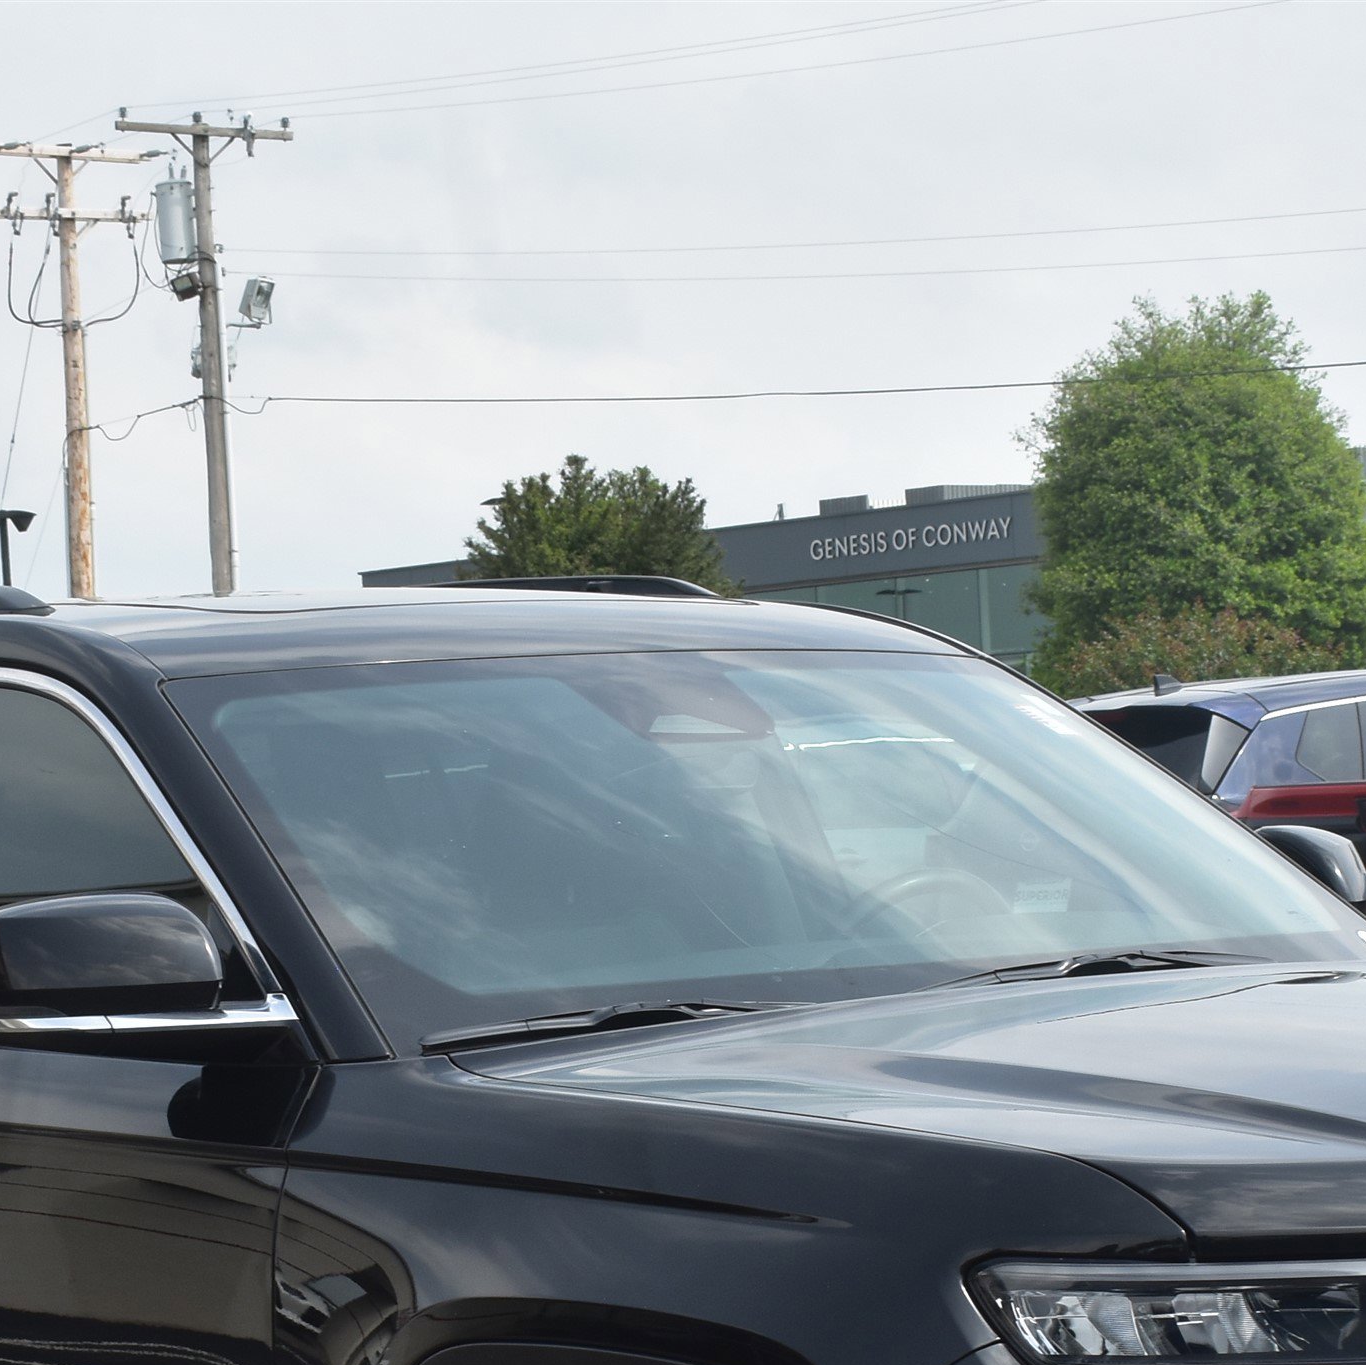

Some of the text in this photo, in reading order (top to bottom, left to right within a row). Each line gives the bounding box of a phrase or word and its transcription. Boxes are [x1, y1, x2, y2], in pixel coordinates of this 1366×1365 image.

[810, 516, 1011, 561] GENESIS OF CONWAY
